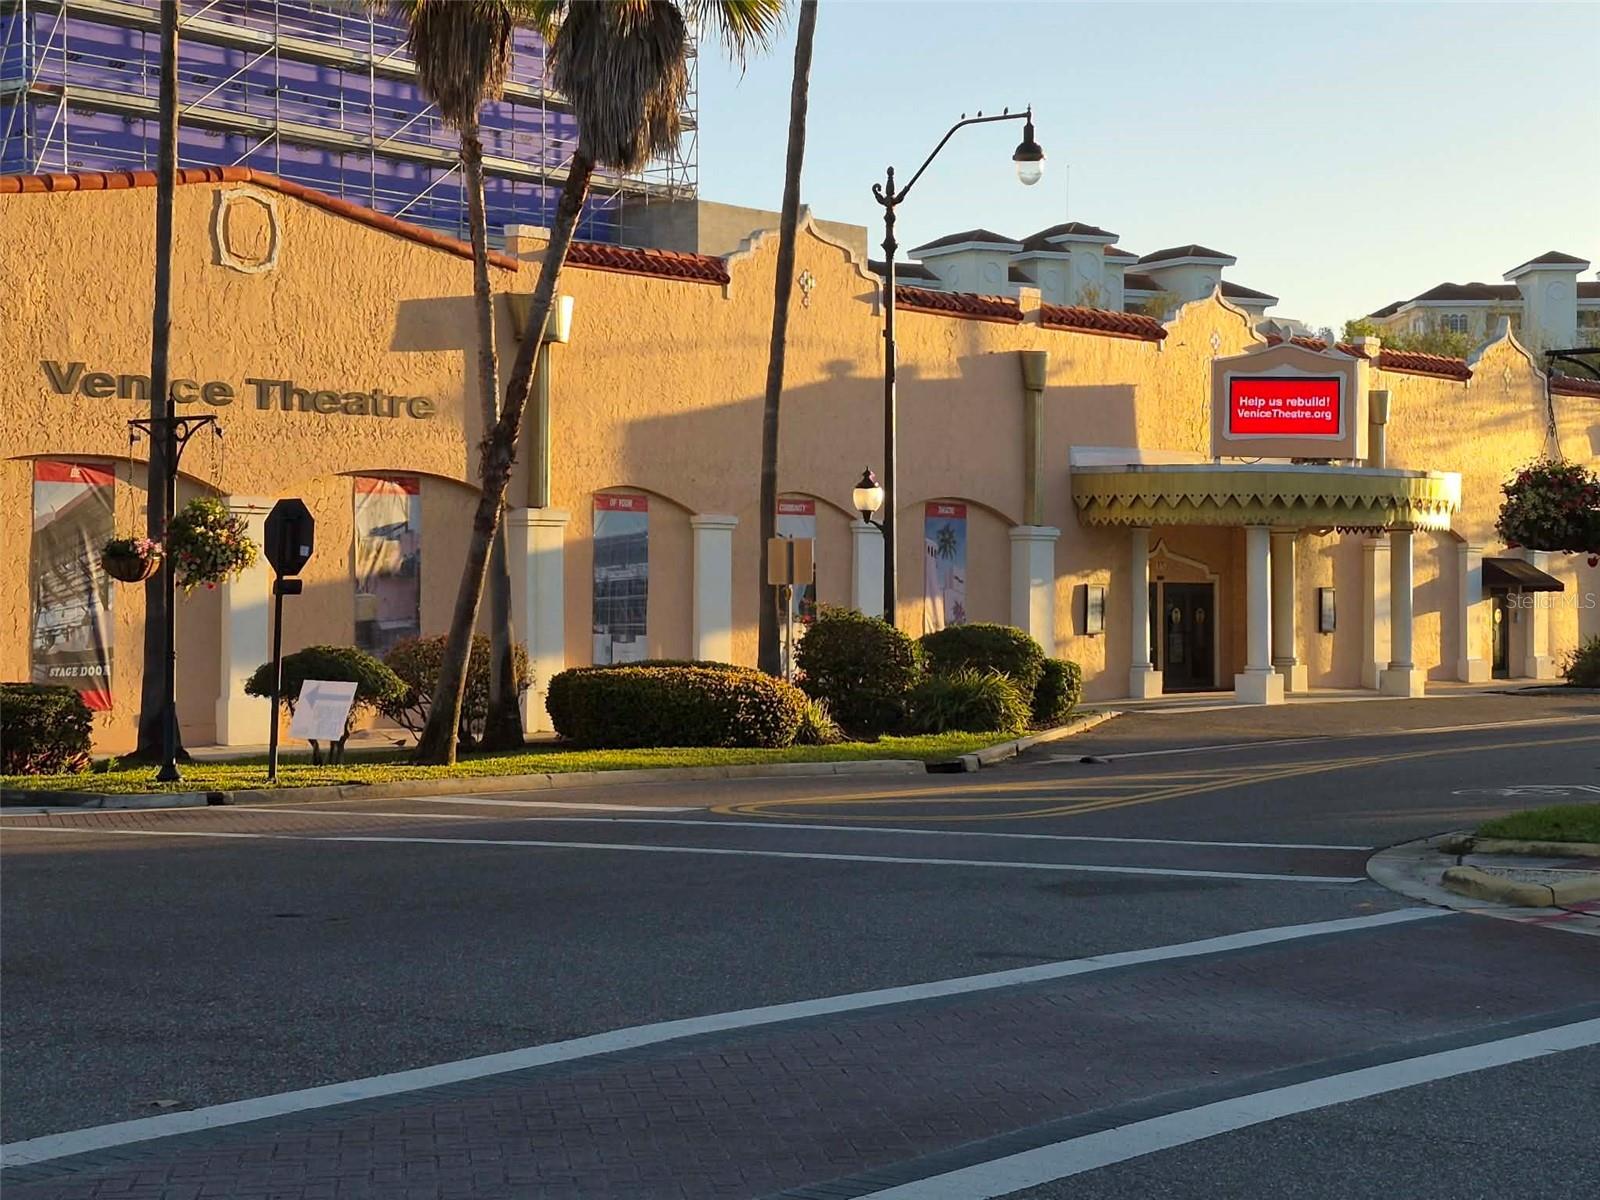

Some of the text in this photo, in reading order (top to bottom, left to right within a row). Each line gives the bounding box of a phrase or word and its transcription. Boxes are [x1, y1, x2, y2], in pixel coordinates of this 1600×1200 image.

[40, 360, 436, 420] Vence Theatre
[1239, 396, 1331, 408] Help us rebuild!
[1237, 409, 1332, 421] VeniceTheatre.org
[48, 666, 79, 678] STAGE
